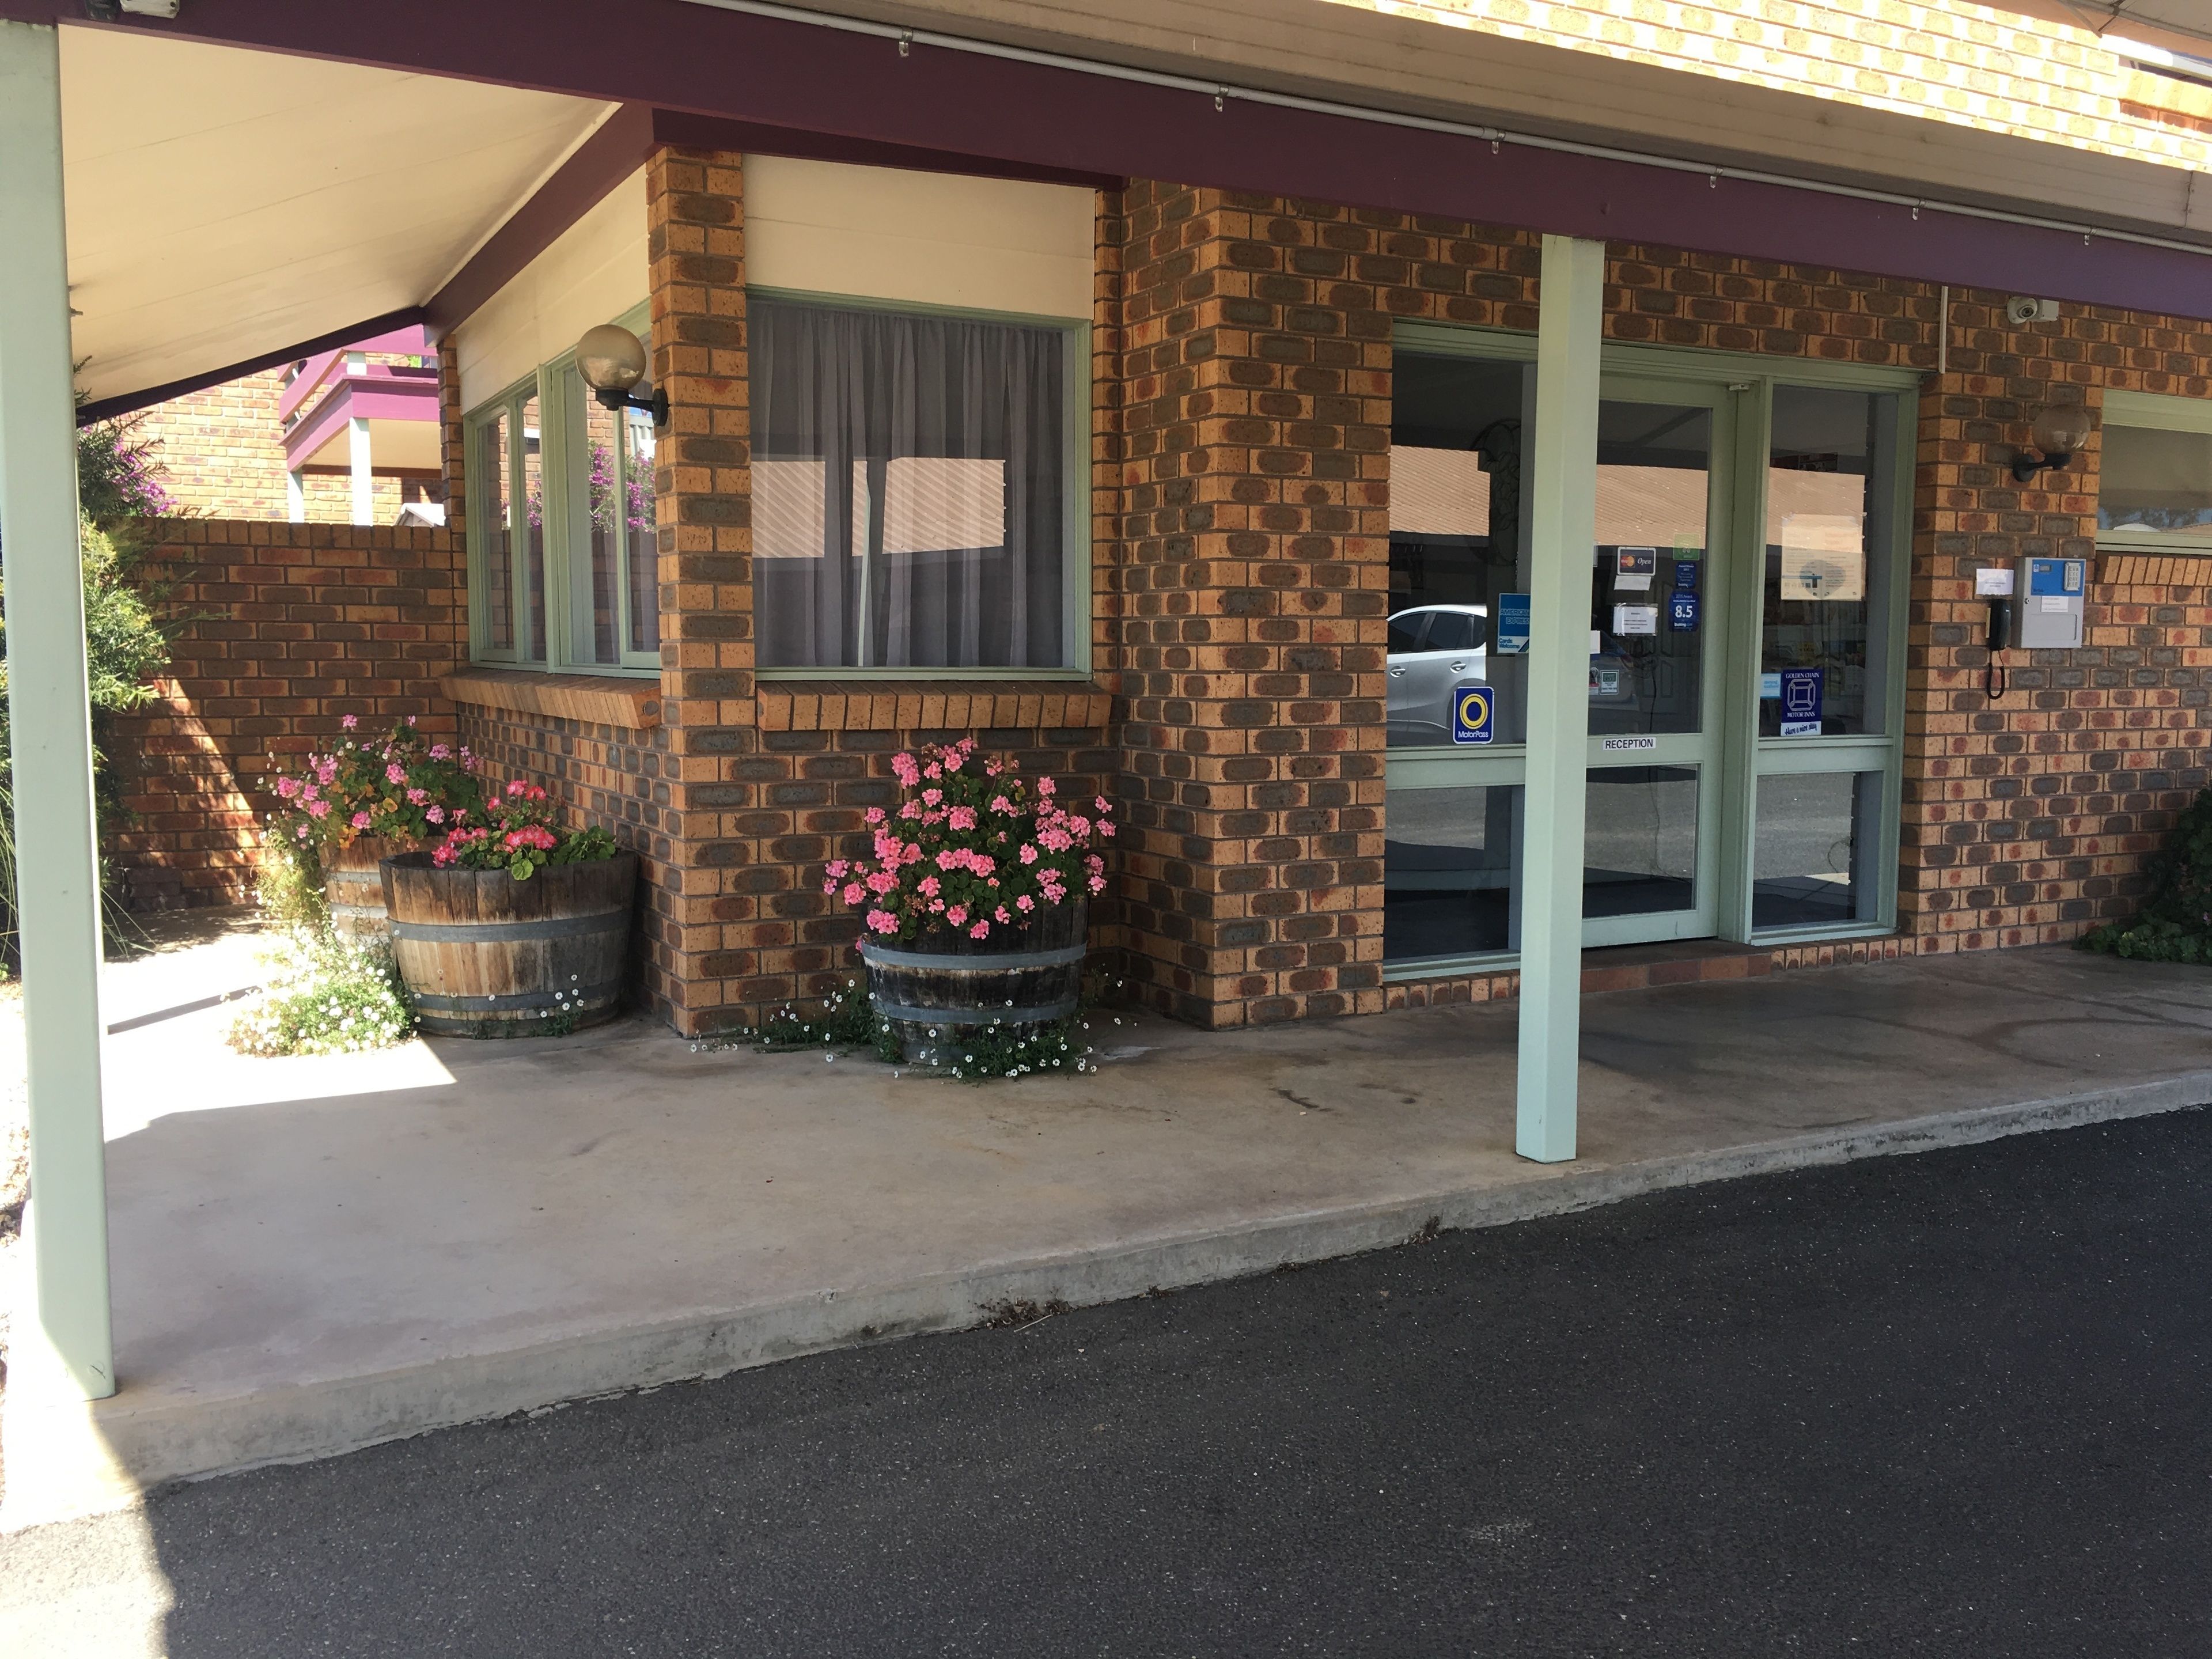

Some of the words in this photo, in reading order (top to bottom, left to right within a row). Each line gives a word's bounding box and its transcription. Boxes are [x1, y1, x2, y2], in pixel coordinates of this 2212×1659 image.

[1637, 558, 1652, 566] Open
[1675, 605, 1693, 618] 8.5
[1785, 727, 1796, 735] Have
[1809, 723, 1817, 731] stay
[1605, 738, 1653, 749] RECEPTION
